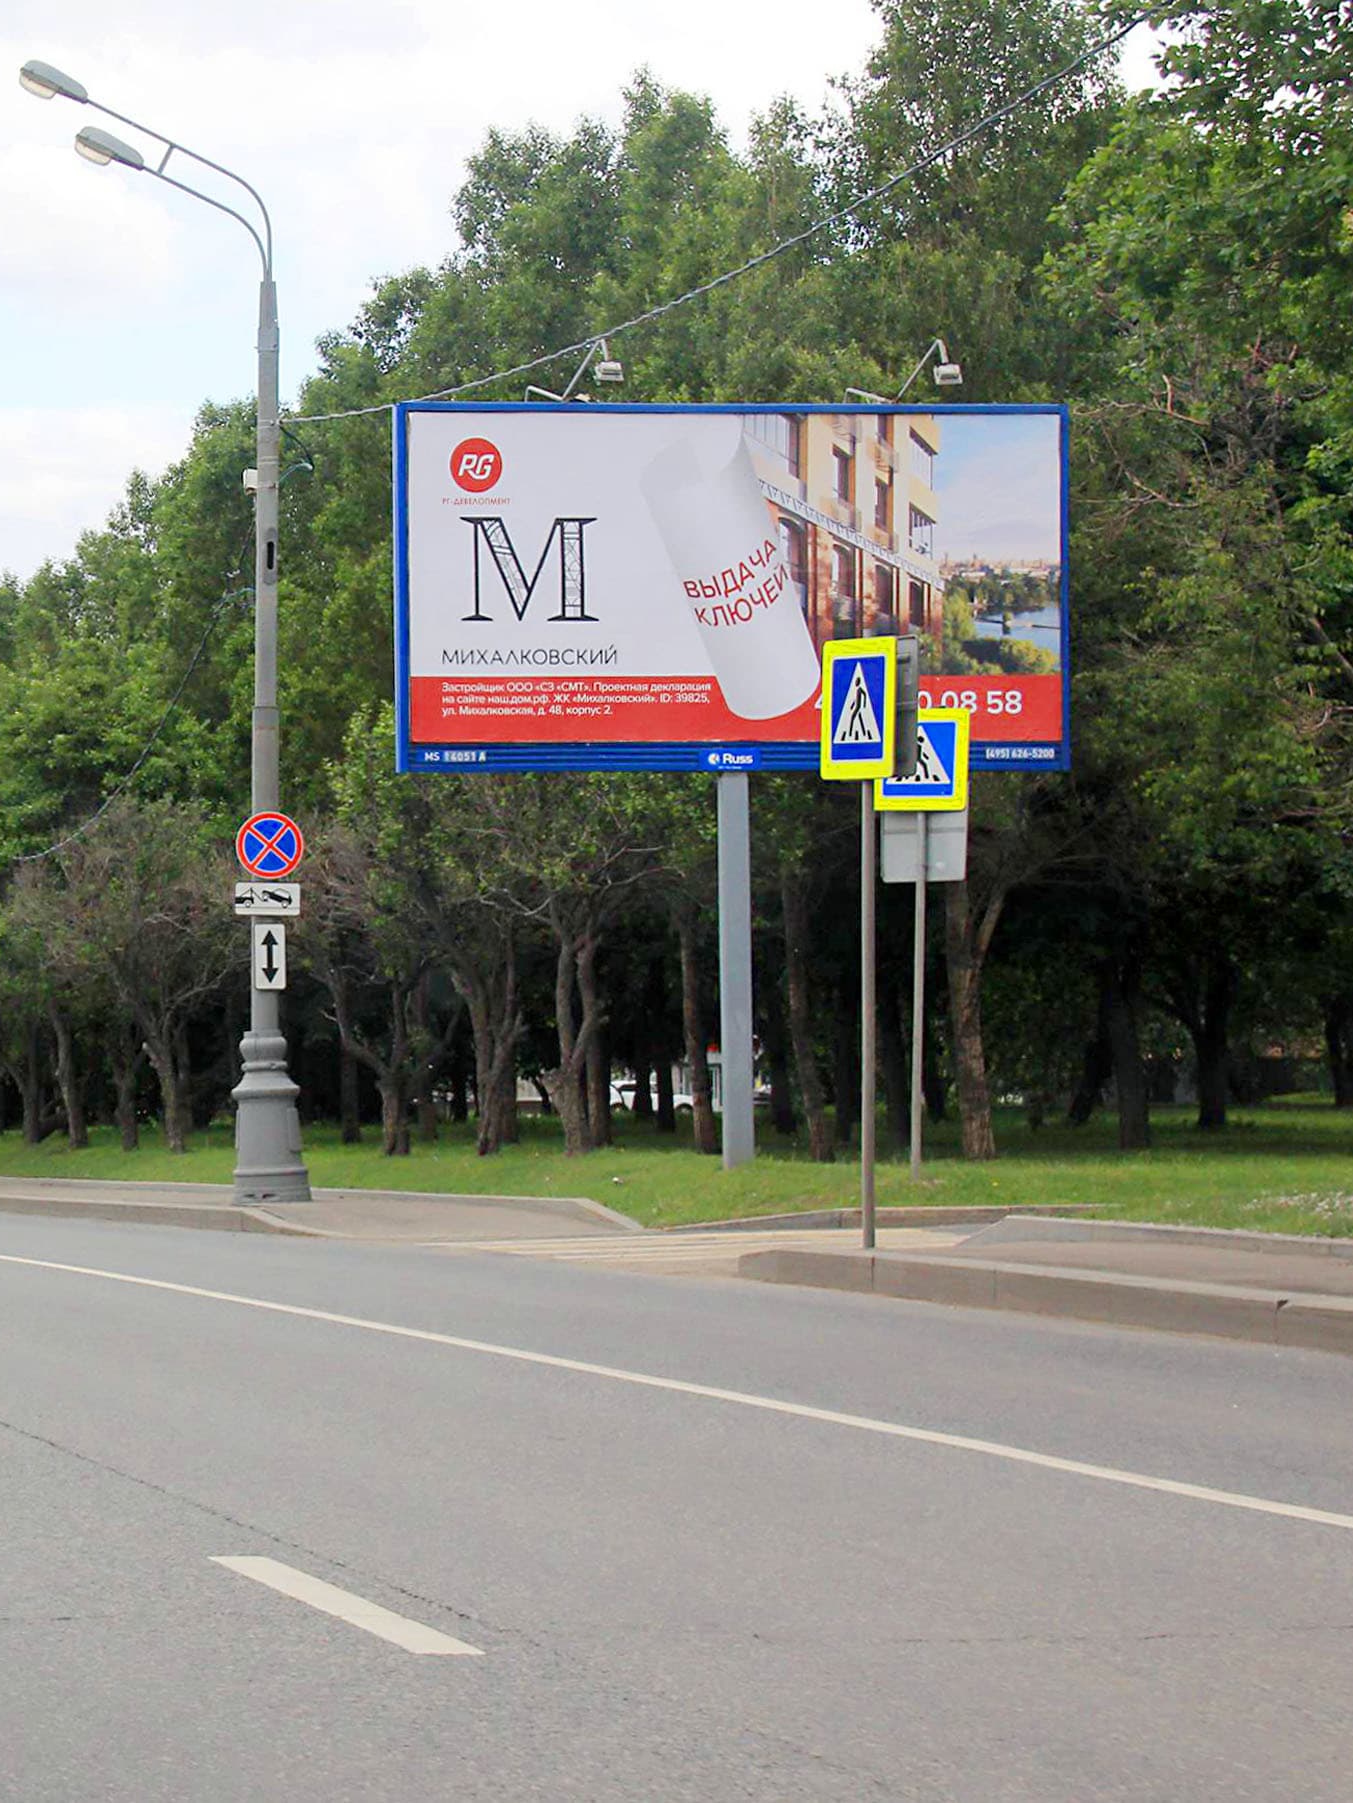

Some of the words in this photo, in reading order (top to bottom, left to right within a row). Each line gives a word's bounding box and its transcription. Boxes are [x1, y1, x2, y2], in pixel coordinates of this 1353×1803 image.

[683, 539, 777, 599] ВЫДАЧА
[694, 563, 789, 627] КЛЮЧЕЙ
[441, 644, 618, 665] МИХАЛКОВСКИЙ
[442, 681, 505, 693] Застройщик
[506, 681, 533, 692] ООО
[593, 681, 648, 693] Проектная
[650, 682, 711, 693] декларация
[442, 695, 455, 704] на
[456, 694, 486, 704] сайте
[553, 693, 570, 703] ЖК
[659, 693, 673, 703] ID:
[675, 693, 710, 704] 39825,
[987, 690, 1023, 714] 58
[566, 706, 602, 717] корпус
[424, 751, 440, 761] MS
[722, 753, 754, 765] Russ
